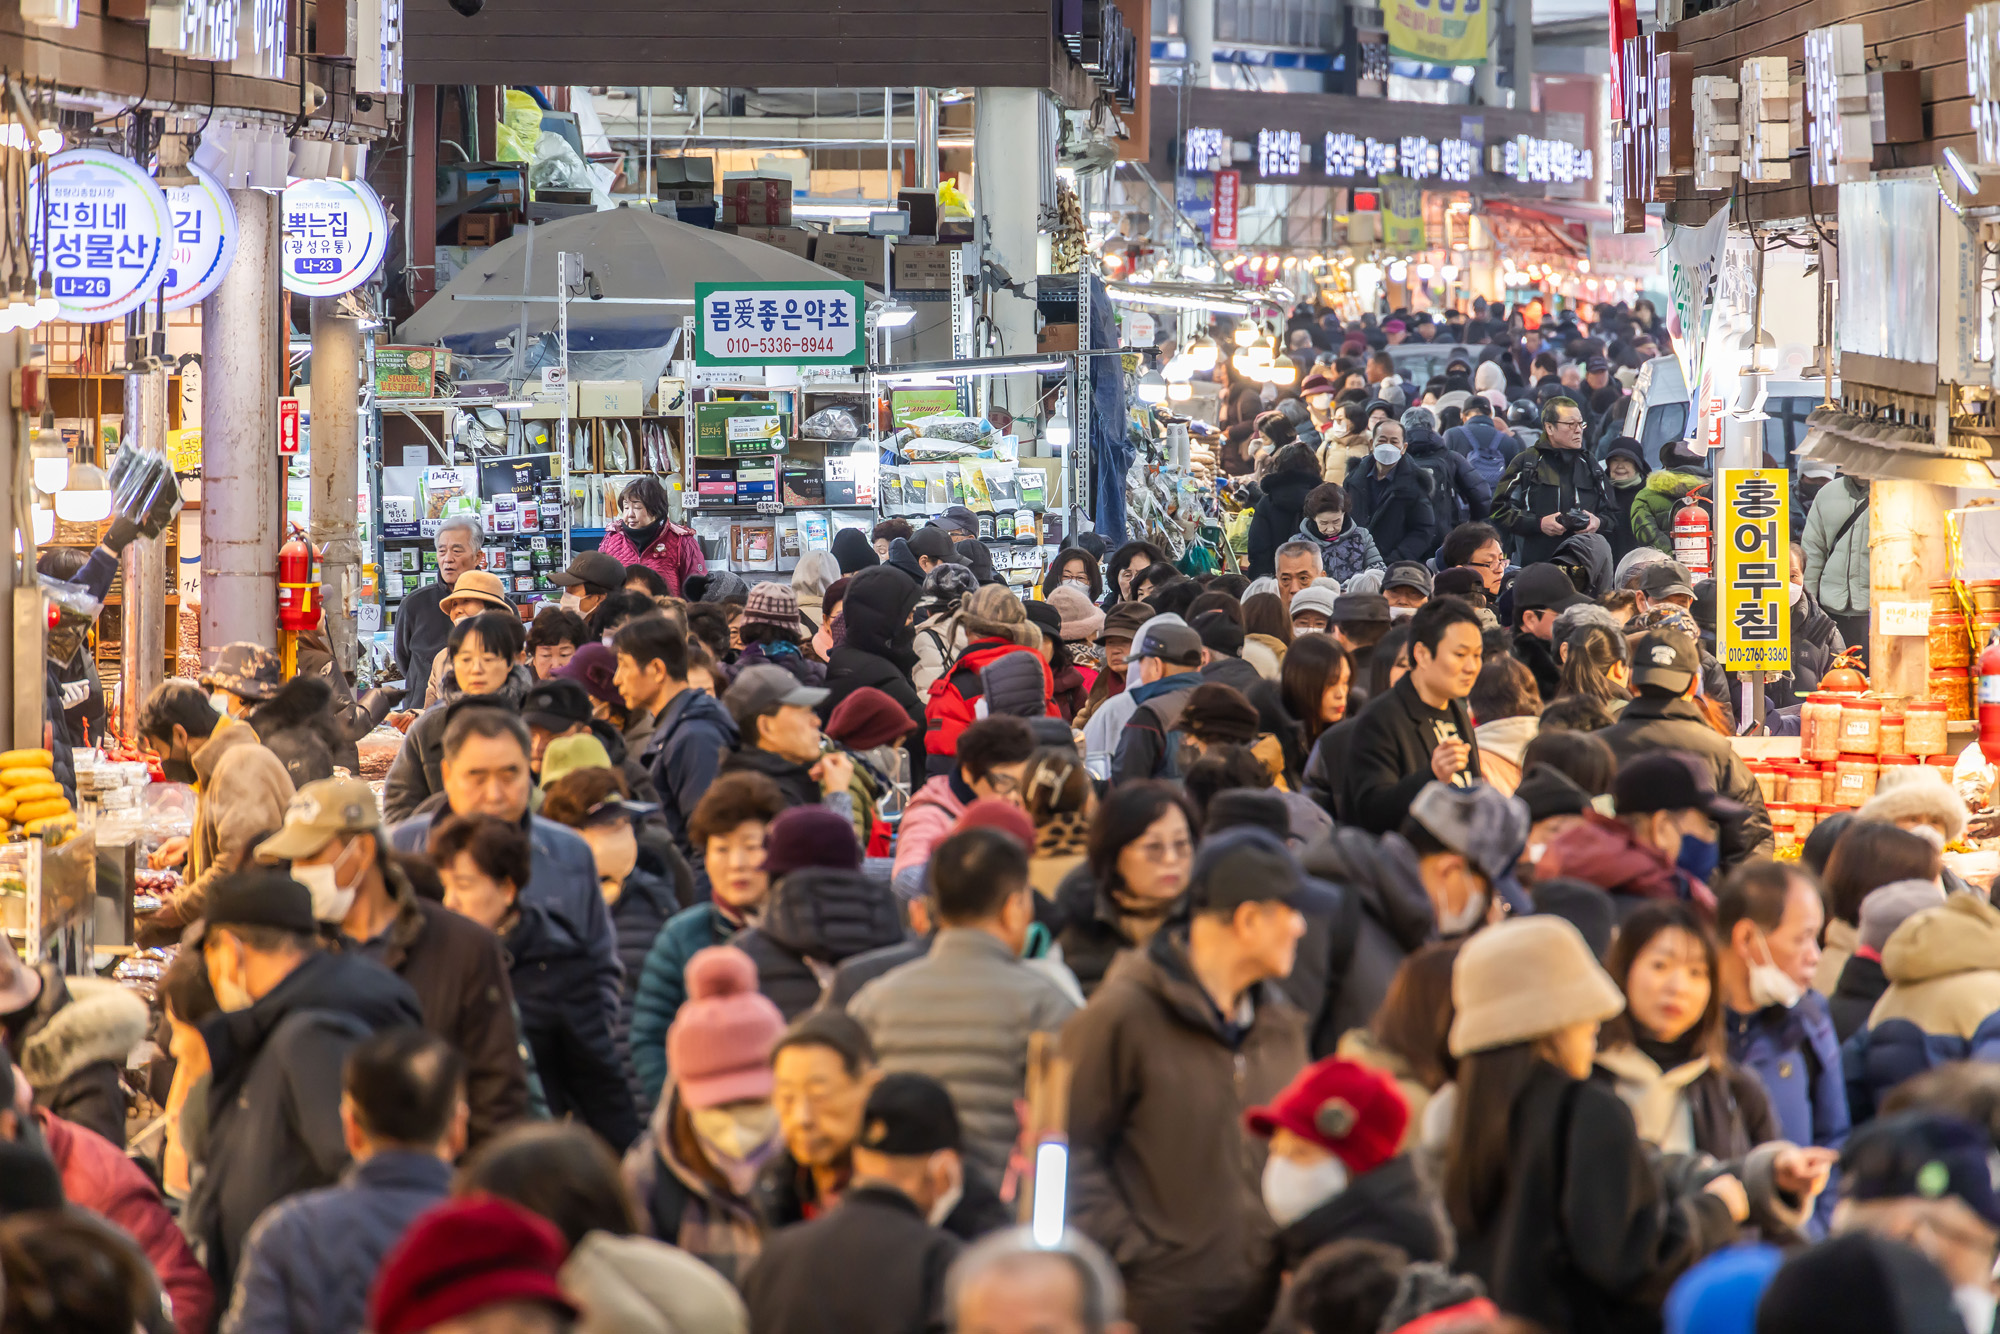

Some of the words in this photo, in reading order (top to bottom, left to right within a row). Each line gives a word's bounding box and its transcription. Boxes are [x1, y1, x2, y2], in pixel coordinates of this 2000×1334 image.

[303, 259, 334, 272] 나-23
[62, 278, 106, 294] 나-26
[727, 337, 834, 353] 010-5336-8944
[380, 381, 426, 392] PODESTA
[387, 375, 419, 383] FARMS
[1732, 478, 1782, 641] 홍어무침
[1728, 647, 1788, 662] 010-2760-3360
